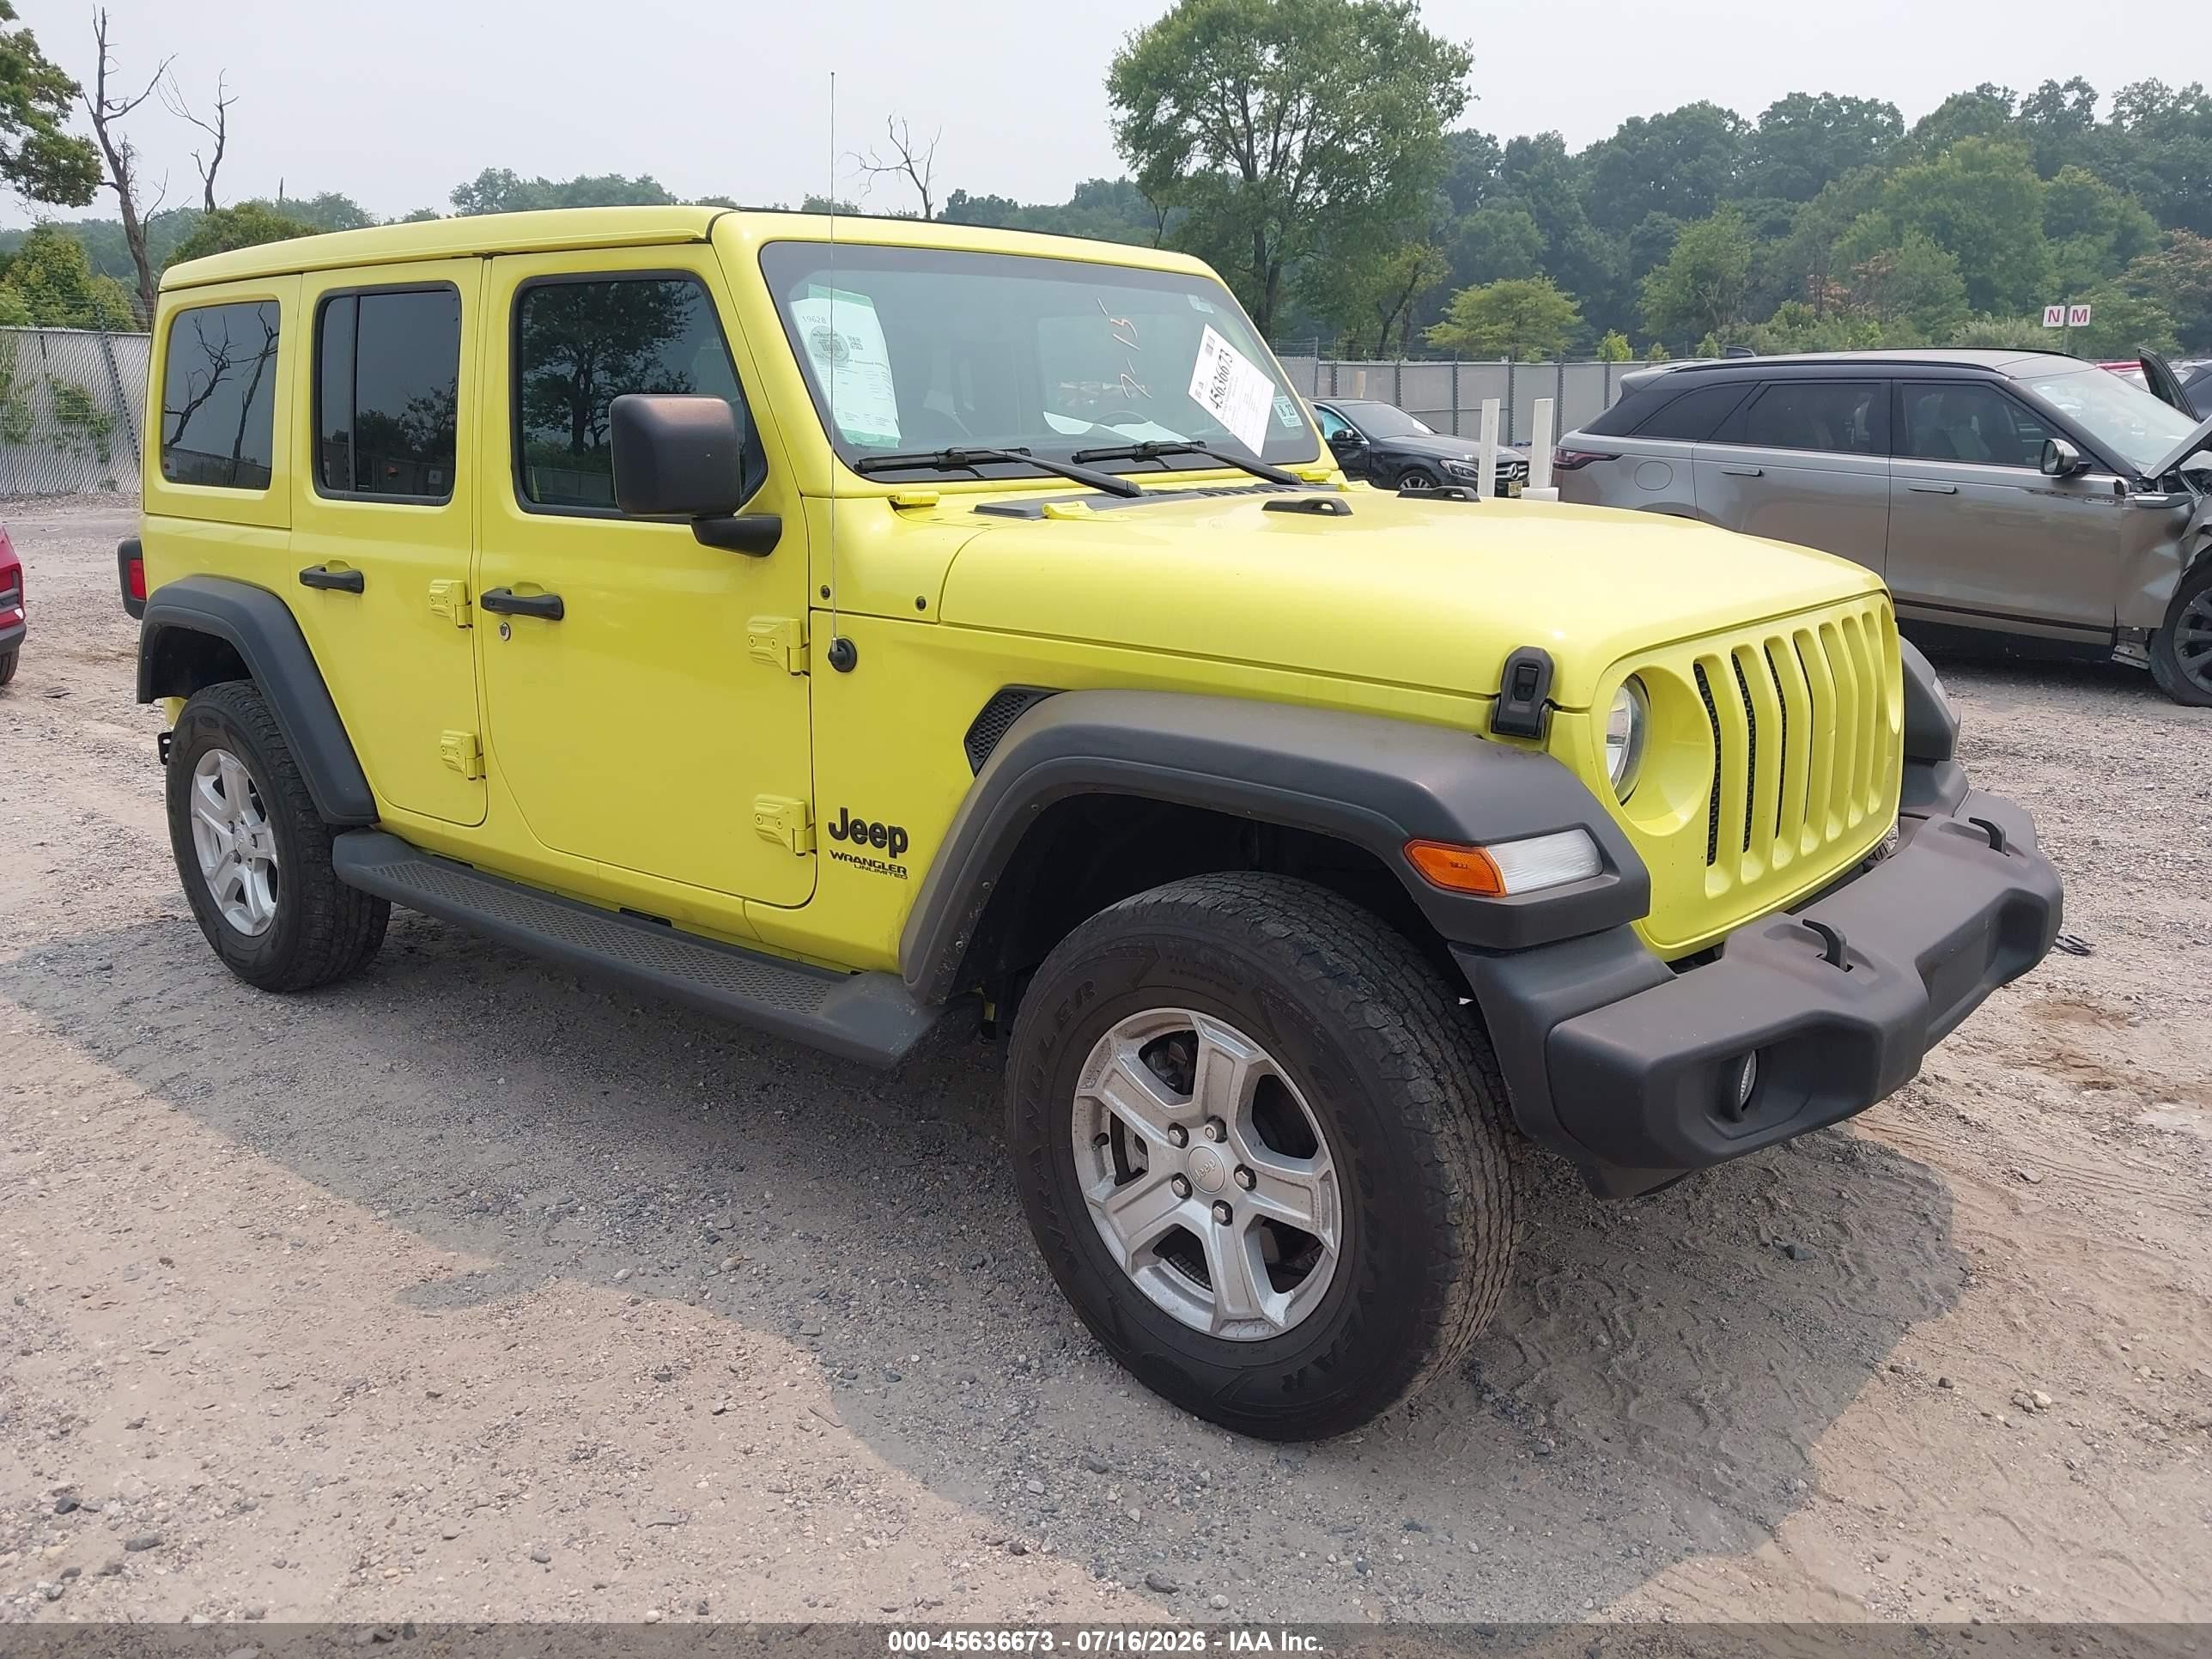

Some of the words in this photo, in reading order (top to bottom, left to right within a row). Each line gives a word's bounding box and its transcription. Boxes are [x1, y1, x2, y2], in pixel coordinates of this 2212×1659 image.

[2047, 308, 2061, 323] N
[2071, 308, 2087, 323] M
[1208, 348, 1234, 410] 45636673
[828, 807, 908, 859] Jeep
[829, 848, 908, 876] WRANGLER
[854, 863, 908, 880] UNLIMITED
[1194, 1158, 1217, 1182] Jeep
